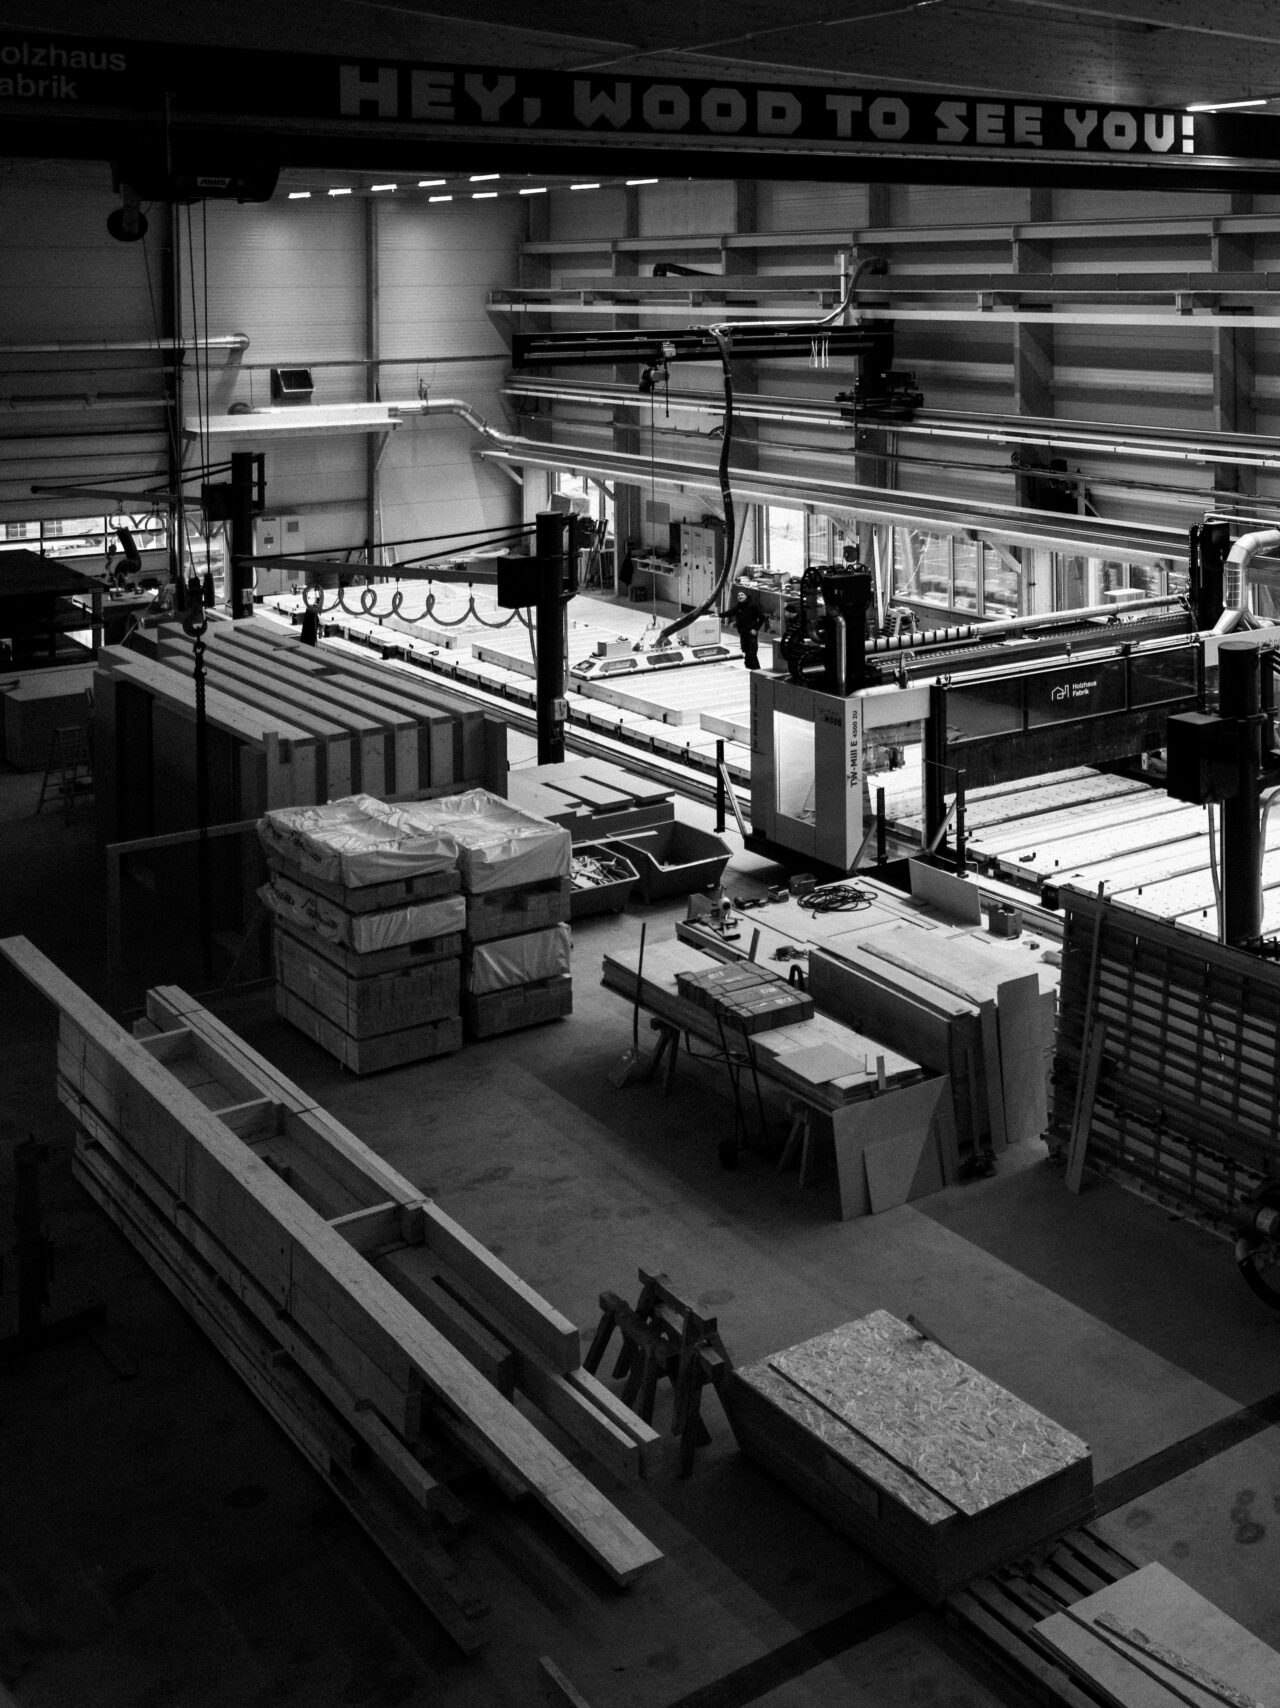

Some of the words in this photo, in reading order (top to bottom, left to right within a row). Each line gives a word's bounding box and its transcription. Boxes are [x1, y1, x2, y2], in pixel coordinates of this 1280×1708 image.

[0, 40, 128, 72] olzhaus
[0, 72, 79, 100] abrik
[339, 64, 542, 128] HEY,
[572, 79, 803, 135] WOOD
[825, 94, 911, 141] TO
[934, 100, 1044, 147] SEE
[1063, 107, 1195, 154] YOU!
[1072, 681, 1097, 690] Holzhaus
[1072, 689, 1089, 697] Fabrik
[850, 749, 858, 788] TW-Mill
